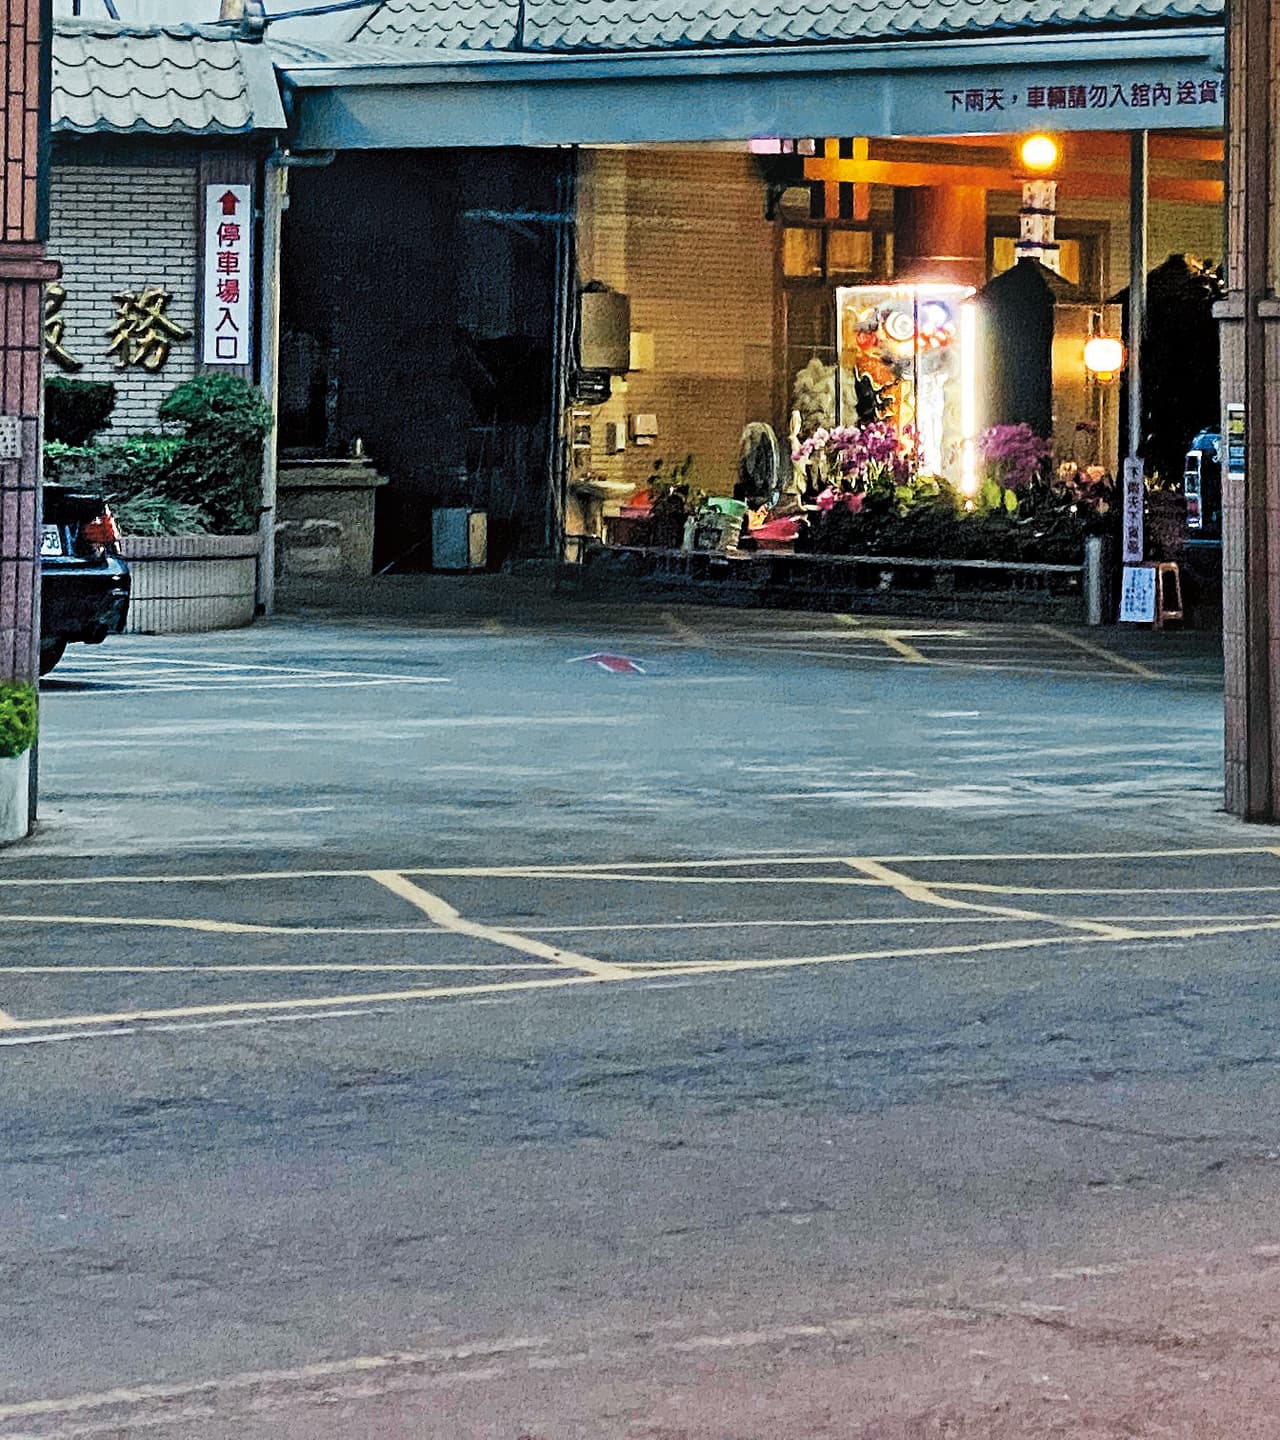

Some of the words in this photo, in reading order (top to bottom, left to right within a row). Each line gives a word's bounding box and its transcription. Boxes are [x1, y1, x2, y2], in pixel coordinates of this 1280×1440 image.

[216, 221, 241, 360] 停車場入口
